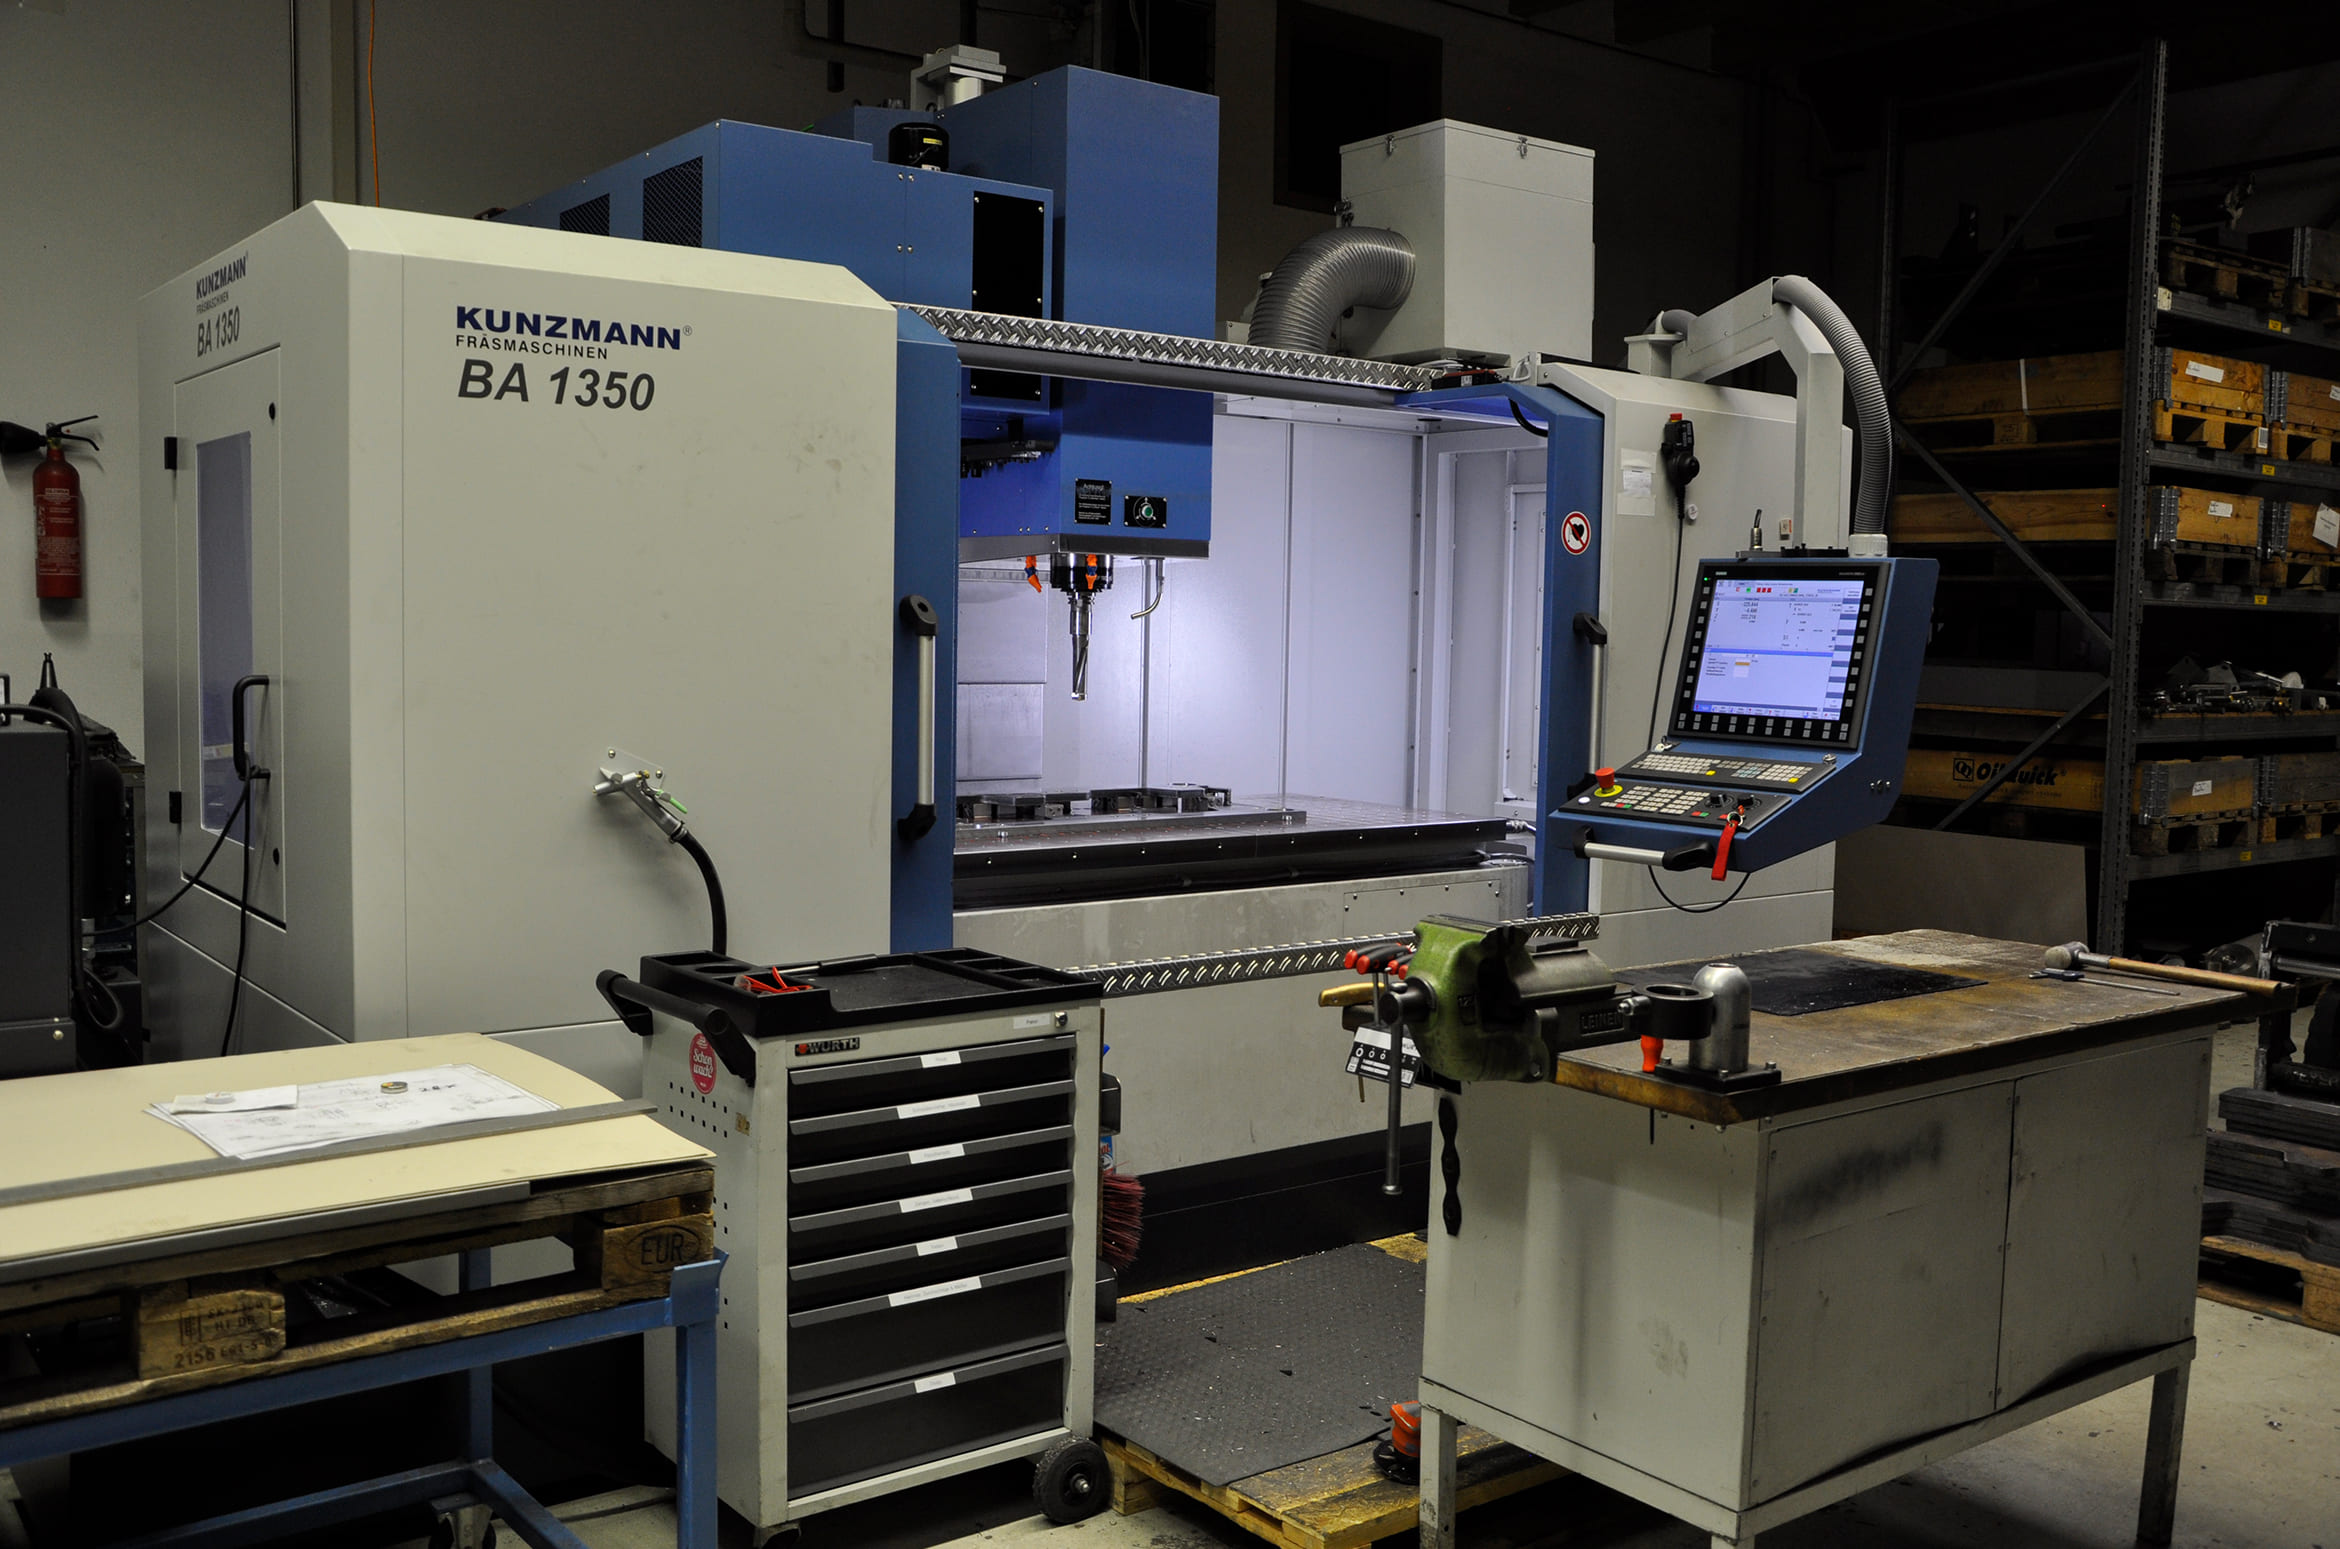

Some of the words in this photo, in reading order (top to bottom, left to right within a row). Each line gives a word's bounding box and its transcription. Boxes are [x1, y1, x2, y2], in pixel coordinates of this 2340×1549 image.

[196, 255, 247, 301] KUNZMANN
[197, 319, 213, 358] BA
[216, 305, 241, 350] 1350
[456, 305, 682, 351] KUNZMANN
[456, 333, 608, 359] FRÄSMASCHINEN
[457, 358, 530, 402] BA
[549, 366, 656, 411] 1350
[641, 1233, 685, 1265] EUR
